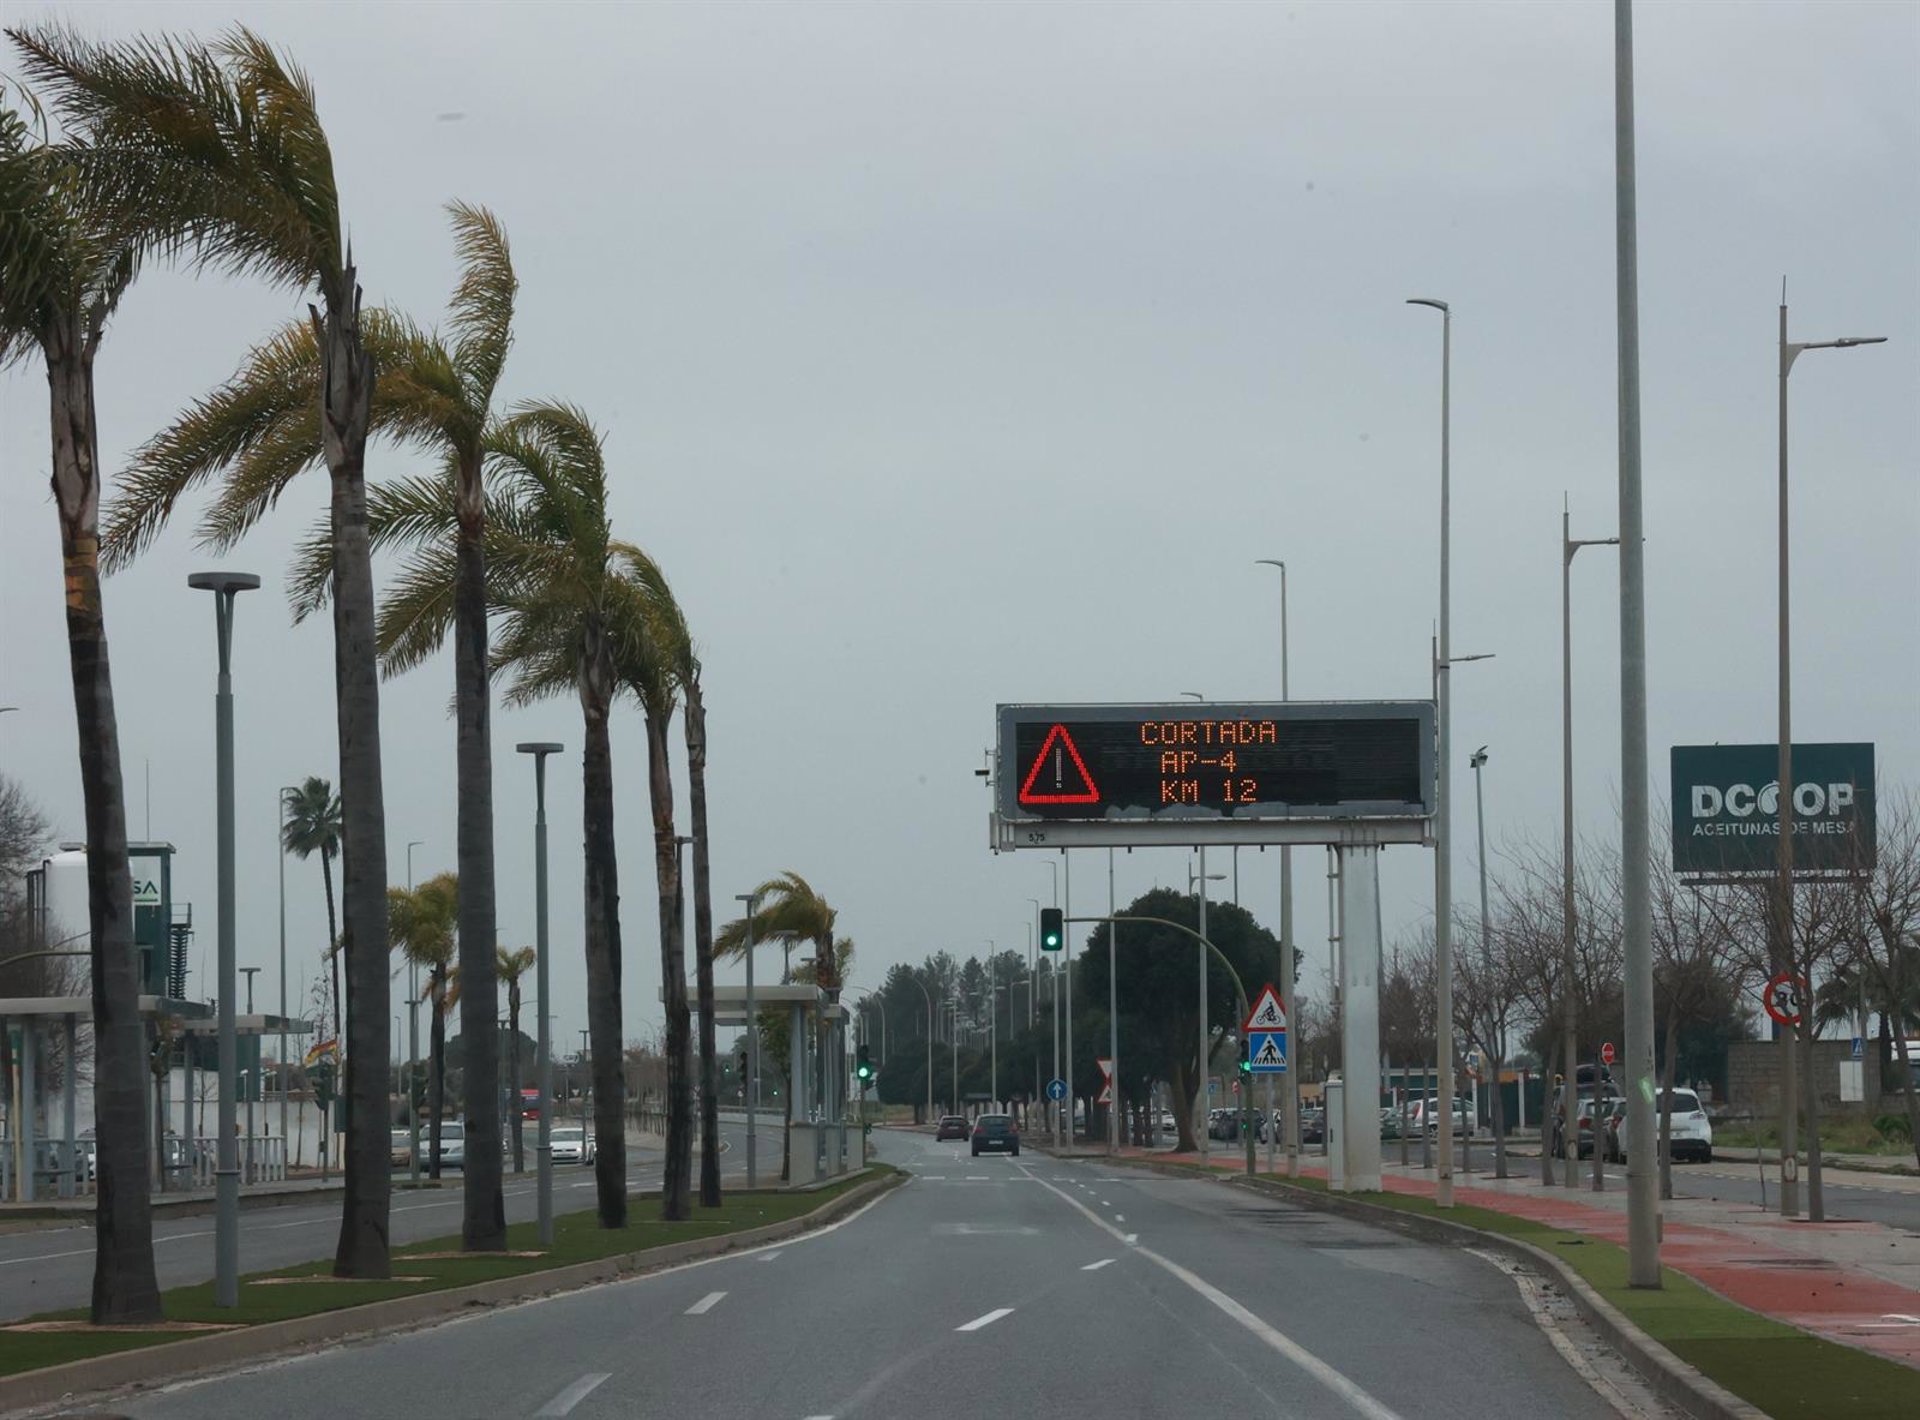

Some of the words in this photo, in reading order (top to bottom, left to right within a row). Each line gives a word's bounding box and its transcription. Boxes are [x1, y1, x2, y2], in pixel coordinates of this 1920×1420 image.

[1141, 721, 1276, 744] CORTADA
[1161, 750, 1237, 773] AP-4
[1161, 779, 1198, 802] KM
[1223, 779, 1257, 802] 12
[1692, 822, 1780, 836] ACEITUNAS
